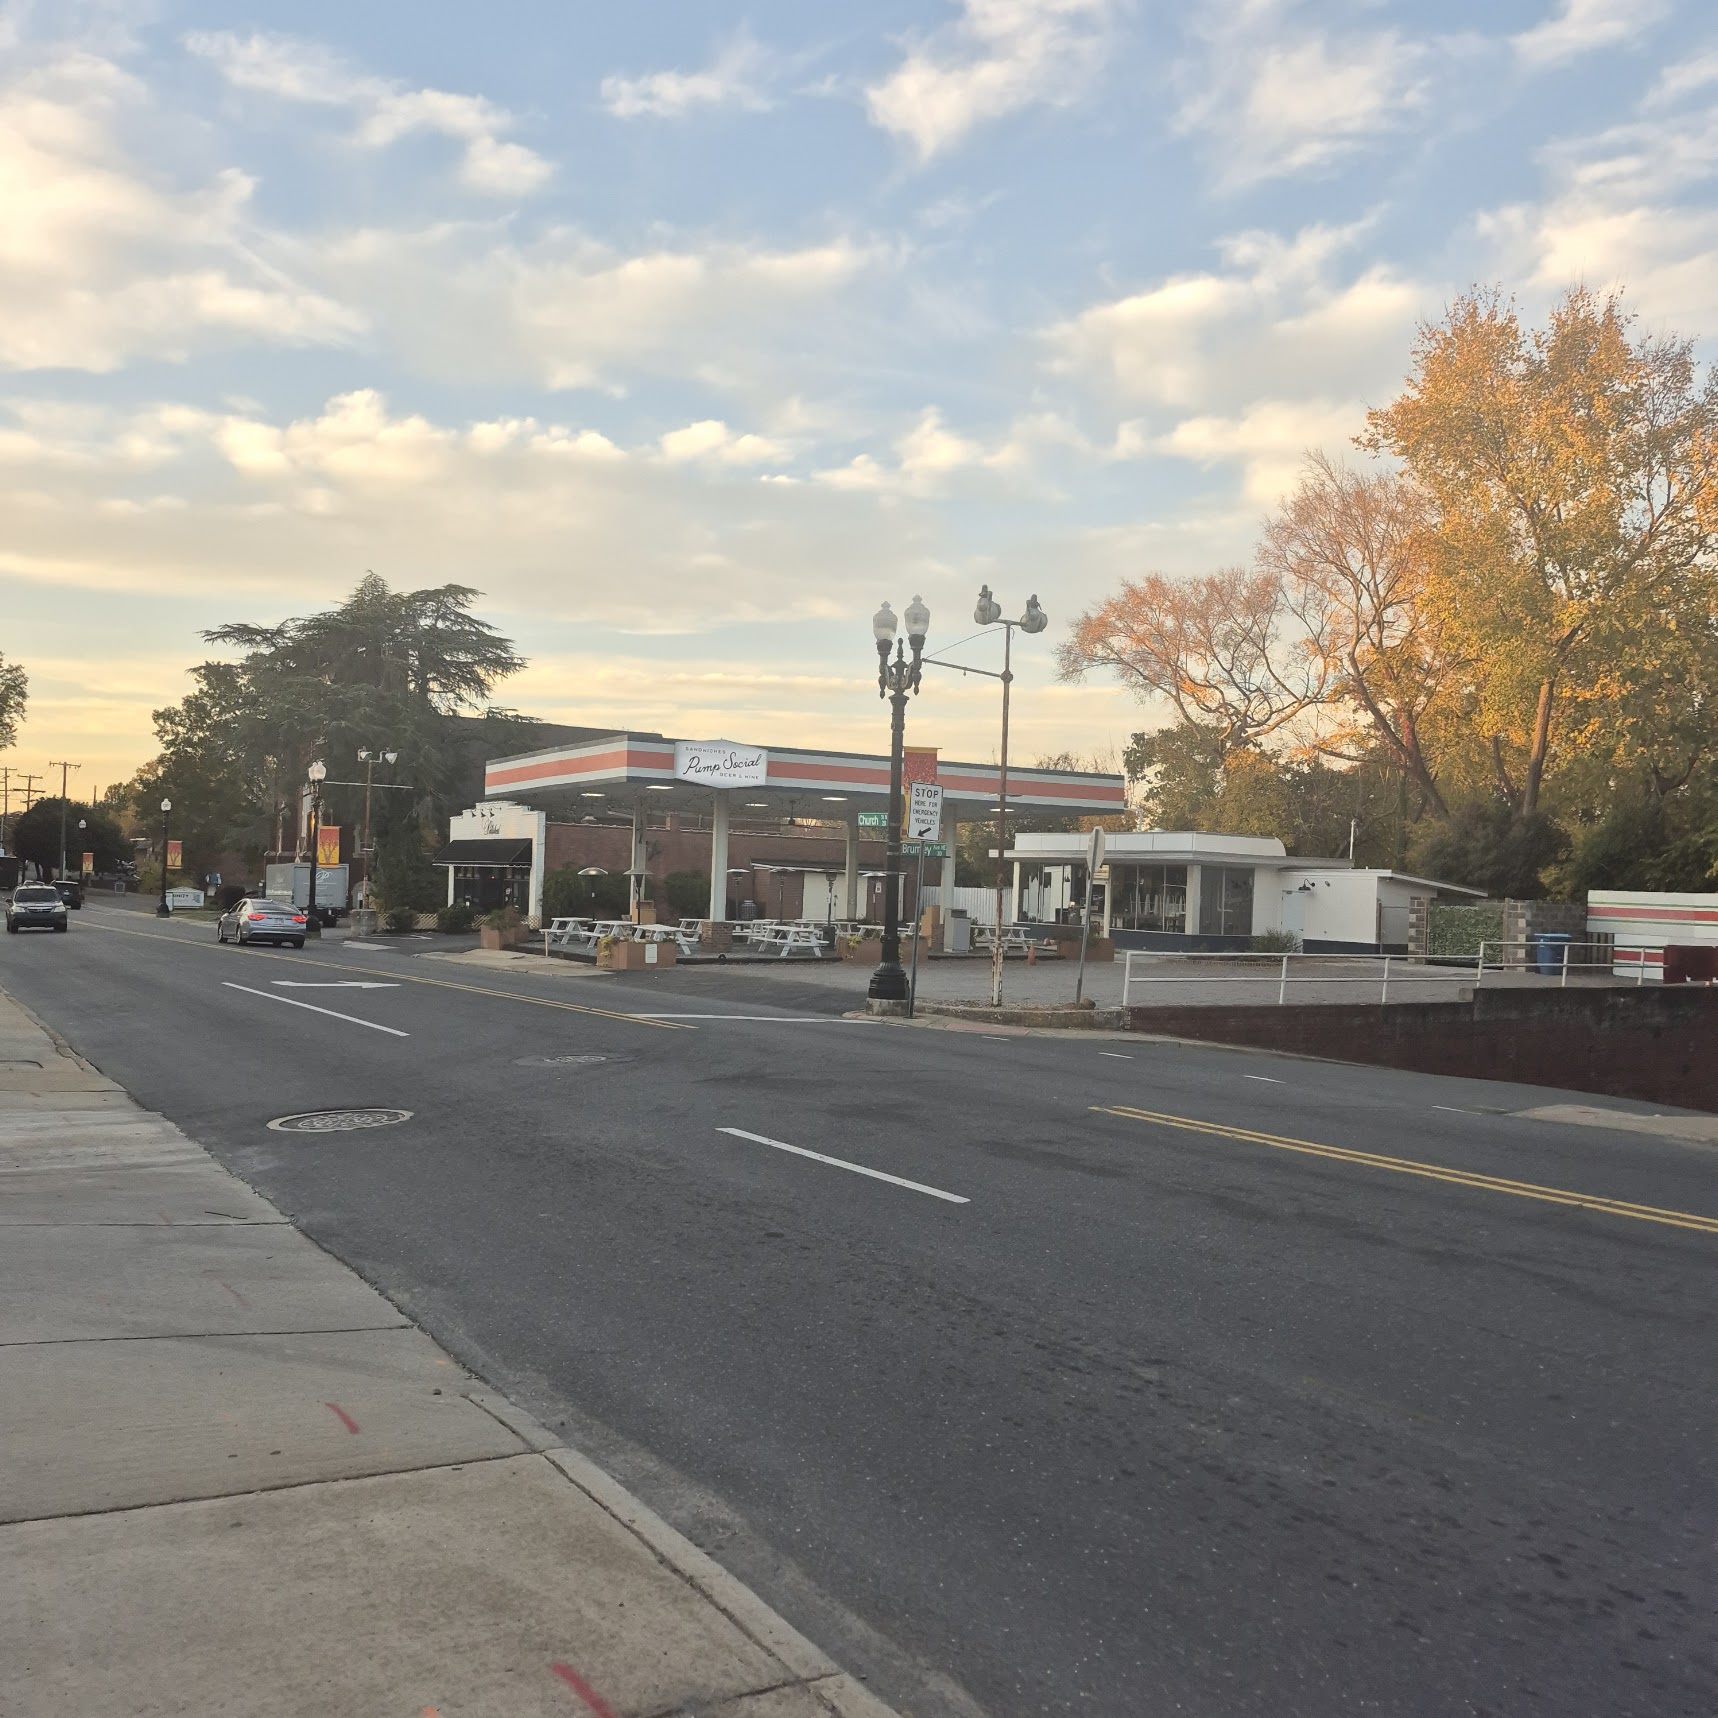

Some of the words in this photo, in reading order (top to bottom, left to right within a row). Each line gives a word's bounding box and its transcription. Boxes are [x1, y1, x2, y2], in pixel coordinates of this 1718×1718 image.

[682, 755, 721, 776] Pump
[722, 751, 762, 770] Social
[914, 788, 939, 799] STOP
[912, 808, 938, 817] EMERGENCY
[858, 814, 879, 826] Church
[914, 817, 936, 826] VEHICLES
